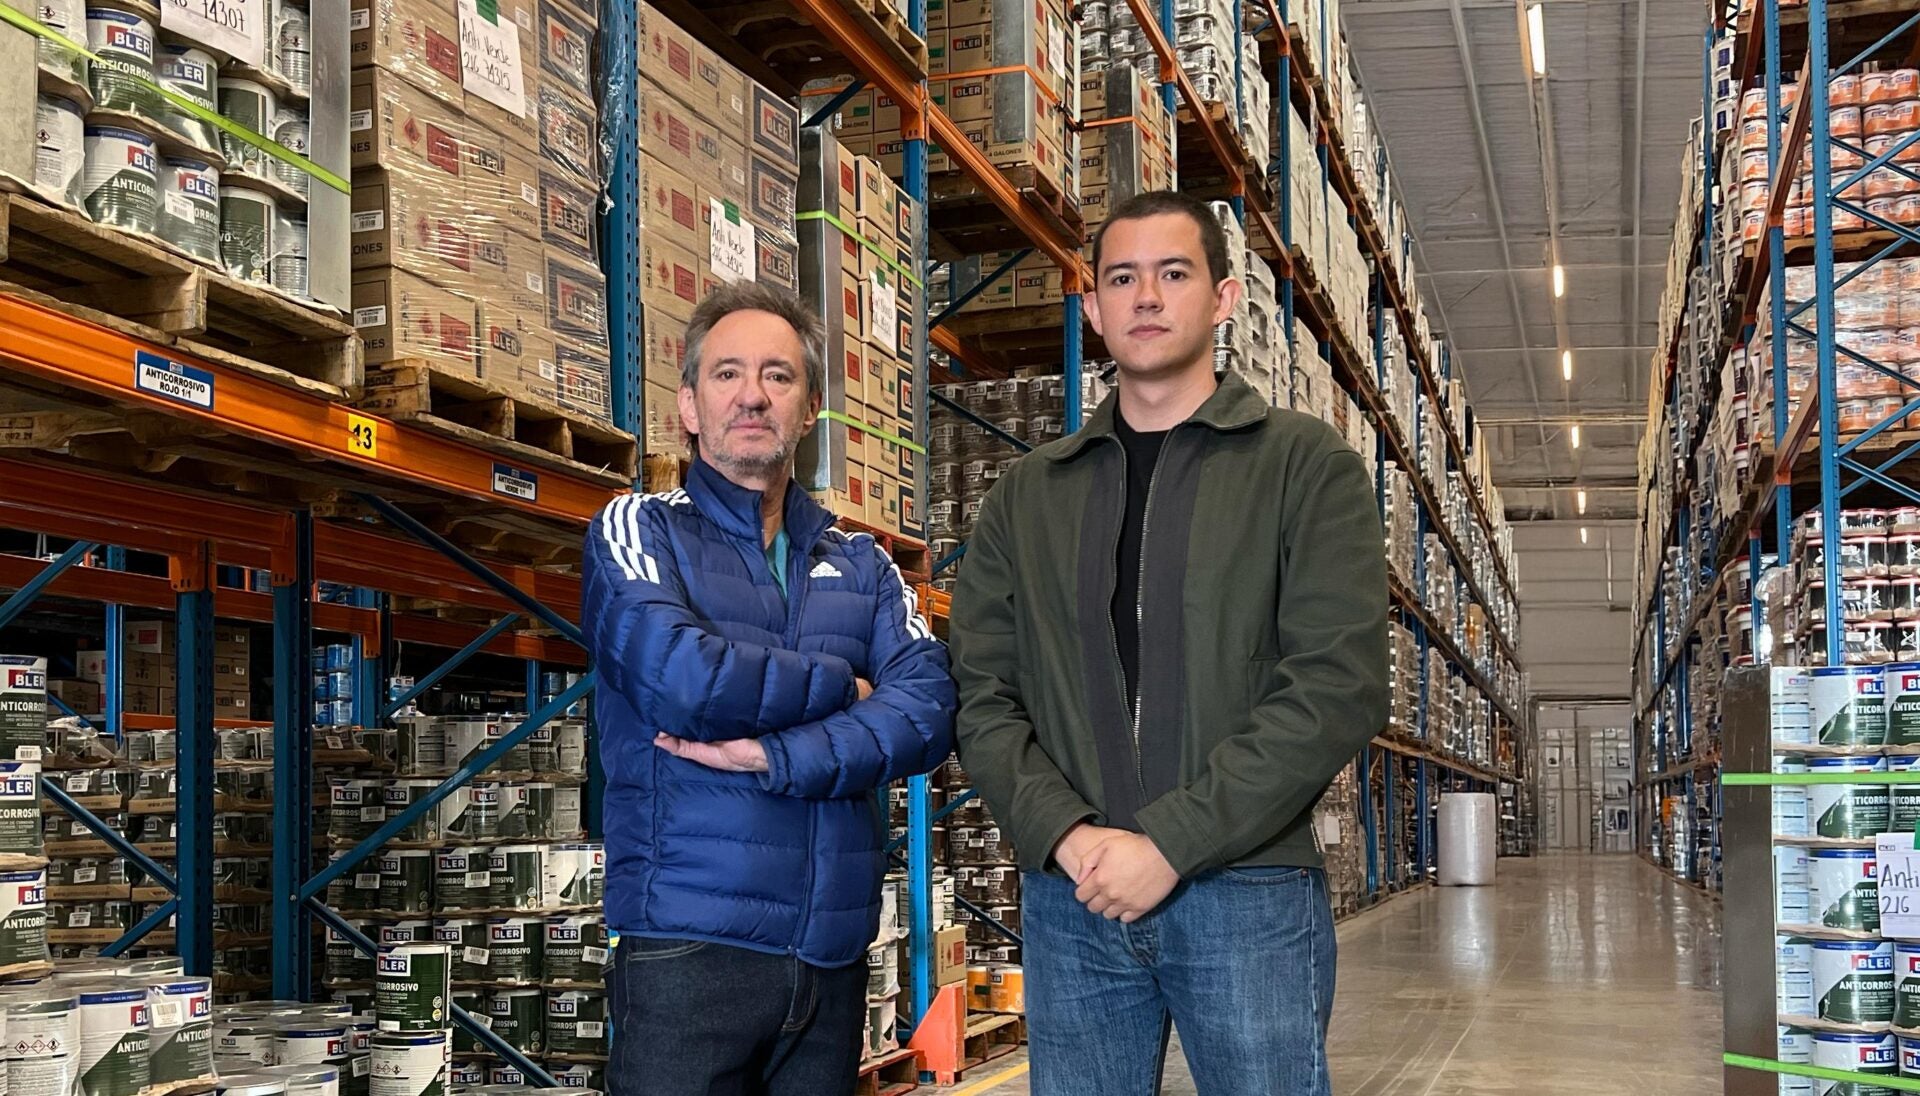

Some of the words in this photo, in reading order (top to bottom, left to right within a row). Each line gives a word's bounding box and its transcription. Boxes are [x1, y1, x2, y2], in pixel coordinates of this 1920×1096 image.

[114, 31, 151, 56] BLER
[956, 38, 981, 49] BLER
[90, 57, 151, 80] ANTICORROS
[162, 62, 203, 82] BLER
[1081, 81, 1097, 90] LER
[956, 86, 981, 97] BLER
[969, 133, 982, 143] ER
[993, 148, 1022, 157] GALONES
[134, 154, 157, 172] BLE
[112, 177, 155, 196] ANTICOR
[185, 178, 217, 200] BLER
[352, 243, 383, 255] ONES
[765, 257, 790, 280] BLER
[1021, 279, 1041, 287] BLER
[493, 331, 519, 356] BLER
[146, 367, 205, 393] ANTICORROSIVO
[160, 382, 180, 395] ROJO
[182, 388, 191, 398] 1/1
[353, 424, 372, 449] 13
[15, 674, 45, 687] BLER
[1907, 679, 1920, 689] BL
[1863, 682, 1884, 692] BL
[0, 701, 46, 712] NTICORROS
[531, 730, 549, 738] LER
[336, 791, 359, 800] BLER
[441, 858, 465, 868] BLER
[1880, 857, 1919, 888] Anti
[24, 890, 45, 902] BLE
[1850, 889, 1877, 898] ANTIC
[1881, 895, 1910, 914] 216
[3, 916, 45, 929] ANTICOR
[332, 931, 342, 939] BL
[385, 931, 410, 940] BLER
[436, 931, 458, 940] BLER
[494, 929, 519, 938] BLER
[552, 929, 577, 939] BLER
[380, 959, 406, 971] BLER
[1858, 958, 1891, 968] BLER
[1839, 981, 1893, 990] ANTICORROS
[1901, 984, 1920, 993] ANTIC
[195, 1001, 211, 1014] BLE
[551, 1002, 573, 1012] BLER
[135, 1011, 148, 1023] BL
[176, 1029, 211, 1043] ANTICOR
[117, 1039, 149, 1053] ANTICO
[332, 1042, 348, 1054] BLE
[357, 1038, 370, 1048] BL
[1866, 1051, 1894, 1062] BLER
[1906, 1056, 1920, 1068] BL
[453, 1074, 480, 1083] BLER
[495, 1073, 520, 1082] BLER
